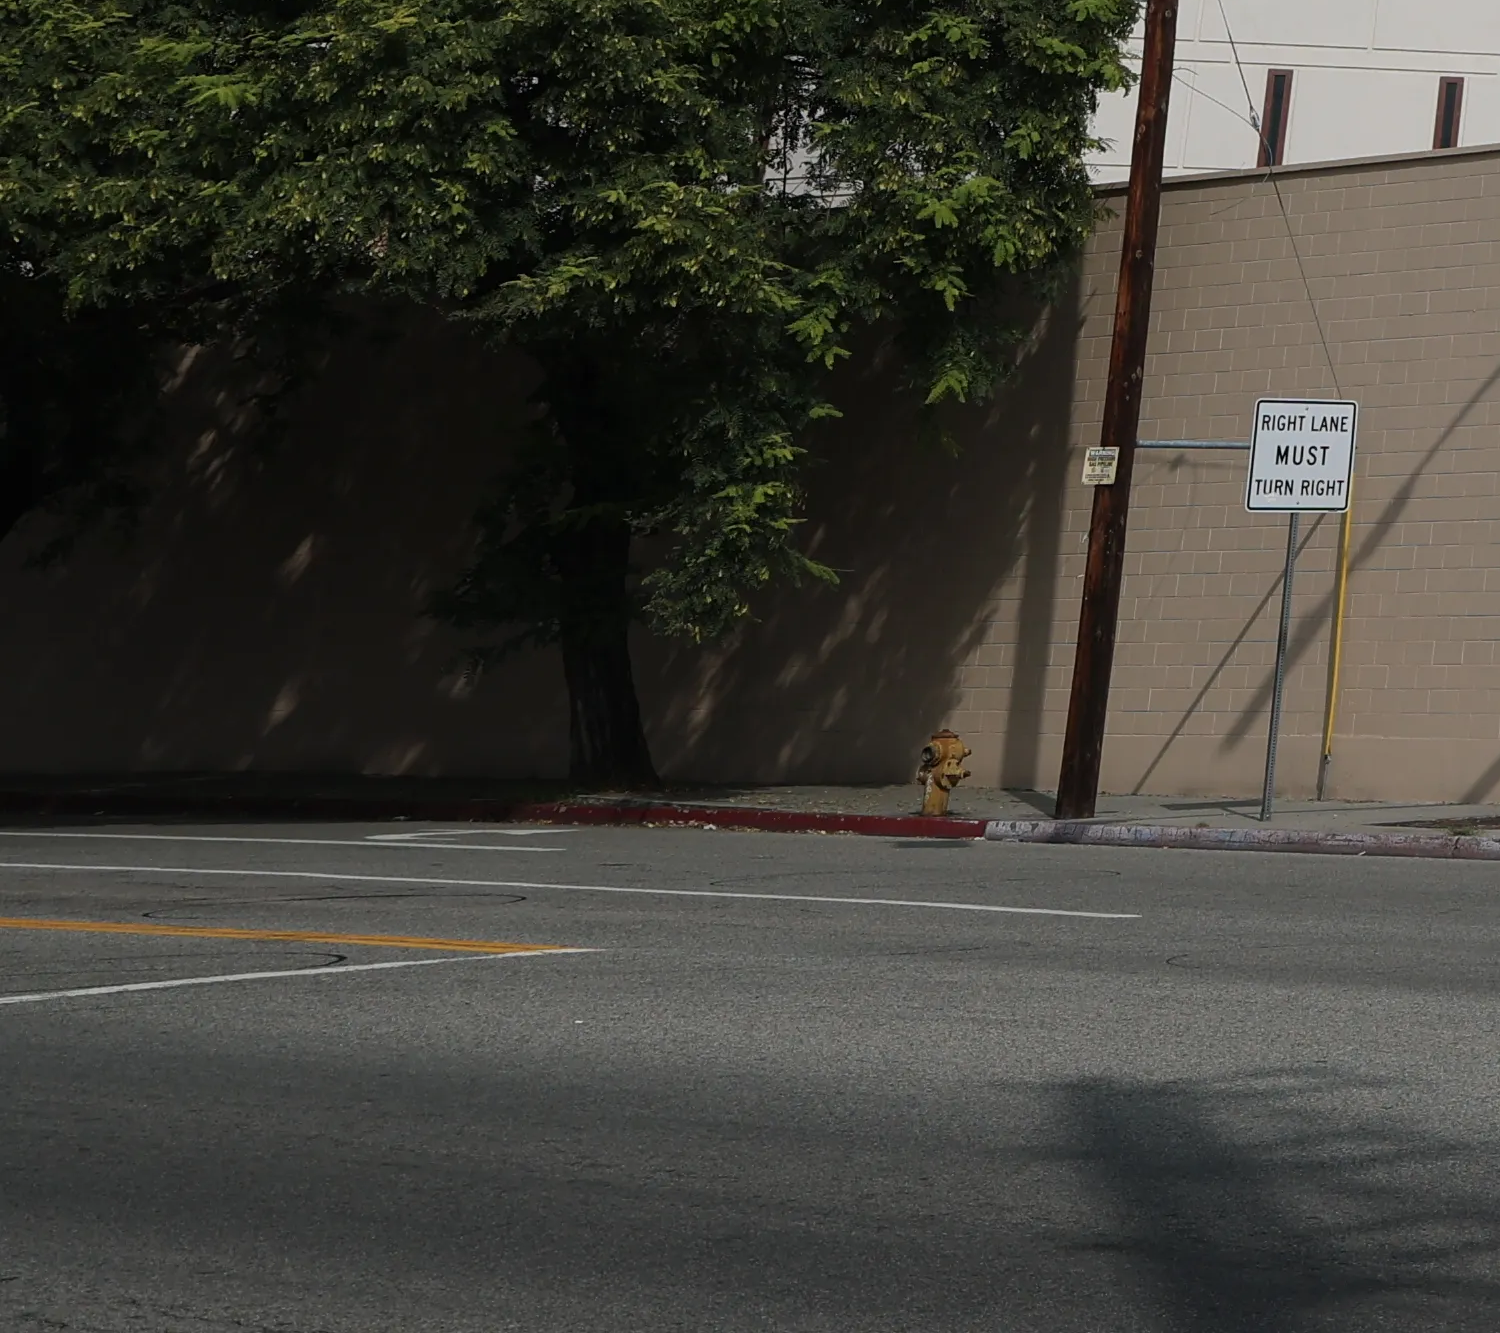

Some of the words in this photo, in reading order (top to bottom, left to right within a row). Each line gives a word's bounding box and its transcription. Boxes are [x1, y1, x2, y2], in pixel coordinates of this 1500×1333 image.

[1261, 415, 1306, 431] RIGHT
[1311, 416, 1349, 432] LANE
[1275, 445, 1330, 466] MUST
[1255, 479, 1294, 496] TURN
[1300, 479, 1345, 496] RIGHT
